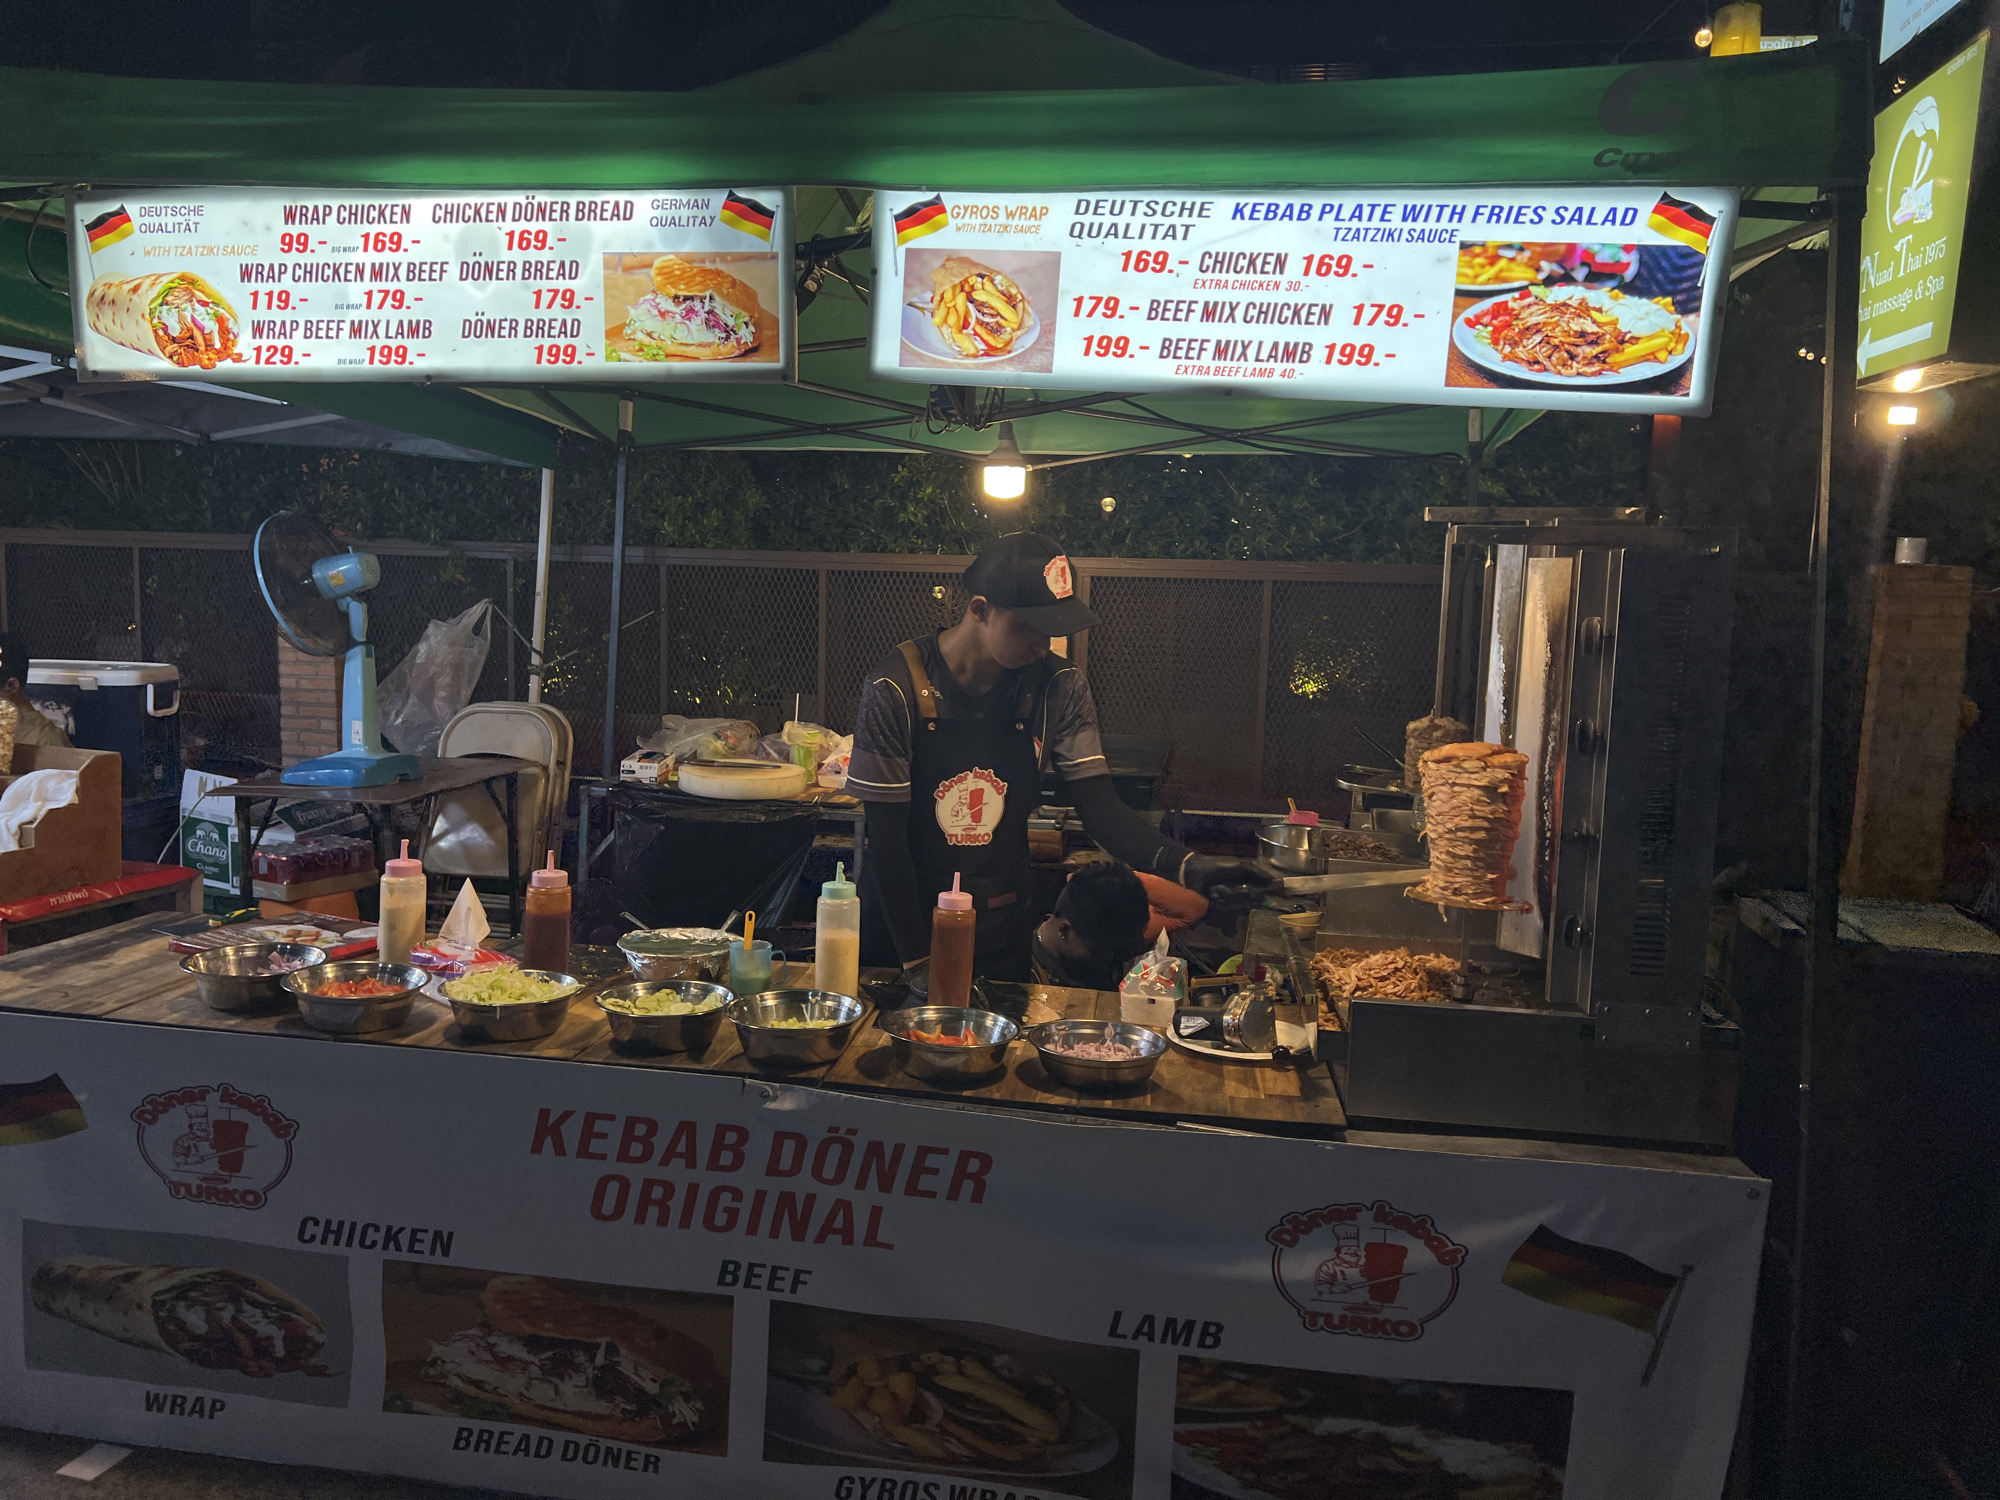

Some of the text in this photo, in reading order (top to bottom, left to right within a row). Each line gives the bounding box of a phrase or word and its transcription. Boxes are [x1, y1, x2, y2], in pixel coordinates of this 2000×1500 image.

[139, 205, 204, 218] DEUTSCHE
[283, 204, 411, 225] WRAP CHICKEN
[432, 196, 634, 223] CHICKEN DÖNER BREAD
[651, 199, 710, 211] GERMAN
[951, 205, 1049, 221] GYROS WRAP
[1074, 199, 1214, 218] DEUTSCHE
[1232, 202, 1638, 227] KEBAB PLATE WITH FRIES SALAD
[139, 219, 200, 234] QUALITÄT
[650, 216, 716, 228] QUALITAY
[956, 223, 1041, 234] WITH TZATZIKI SAUCE
[1069, 222, 1196, 241] QUALITAT
[280, 232, 327, 253] 99.-
[361, 232, 420, 253] 169.-
[505, 229, 566, 251] 169.-
[1333, 227, 1458, 244] TZATZIKI SAUCE
[143, 244, 258, 257] WITH TZATZIKI SAUCE
[240, 261, 449, 283] WRAP CHICKEN MIX BEEF
[459, 252, 580, 281] DÖNER BREAD
[1121, 250, 1374, 278] 169.- CHICKEN 169.-
[1861, 234, 1947, 293] Nuad Thai 1975
[1193, 279, 1310, 292] EXTRA CHICKEN 30.-
[250, 290, 308, 310] 119.-
[364, 289, 423, 310] 179.-
[532, 288, 593, 310] 179.-
[1859, 275, 1944, 322] hai massage & Spa
[1072, 296, 1425, 327] 179.- BEEF MIX CHICKEN 179.-
[251, 319, 432, 340] WRAP BEEF MIX LAMB
[462, 312, 581, 339] DÖNER BREAD
[252, 345, 311, 366] 129.-
[367, 345, 425, 365] 199.-
[534, 344, 595, 365] 199.-
[1083, 336, 1396, 367] 199.- BEEF MIX LAMB 199.-
[1175, 365, 1304, 380] EXTRA BEEF LAMB 40.-
[973, 767, 1006, 796] kebab
[947, 833, 991, 844] TURKO
[188, 839, 227, 861] Chang
[530, 1108, 994, 1204] KEBAB DÖNER
[168, 1180, 262, 1206] TURKO
[590, 1174, 895, 1250] ORIGINAL
[298, 1216, 454, 1257] CHICKEN
[1272, 1204, 1463, 1266] Döner kebab
[717, 1259, 812, 1294] BEEF
[1108, 1311, 1224, 1350] LAMB
[1304, 1310, 1419, 1338] TURKO
[144, 1391, 226, 1420] WRAP
[452, 1427, 662, 1474] BREAD DÖNER
[835, 1476, 940, 1500] GYROS
